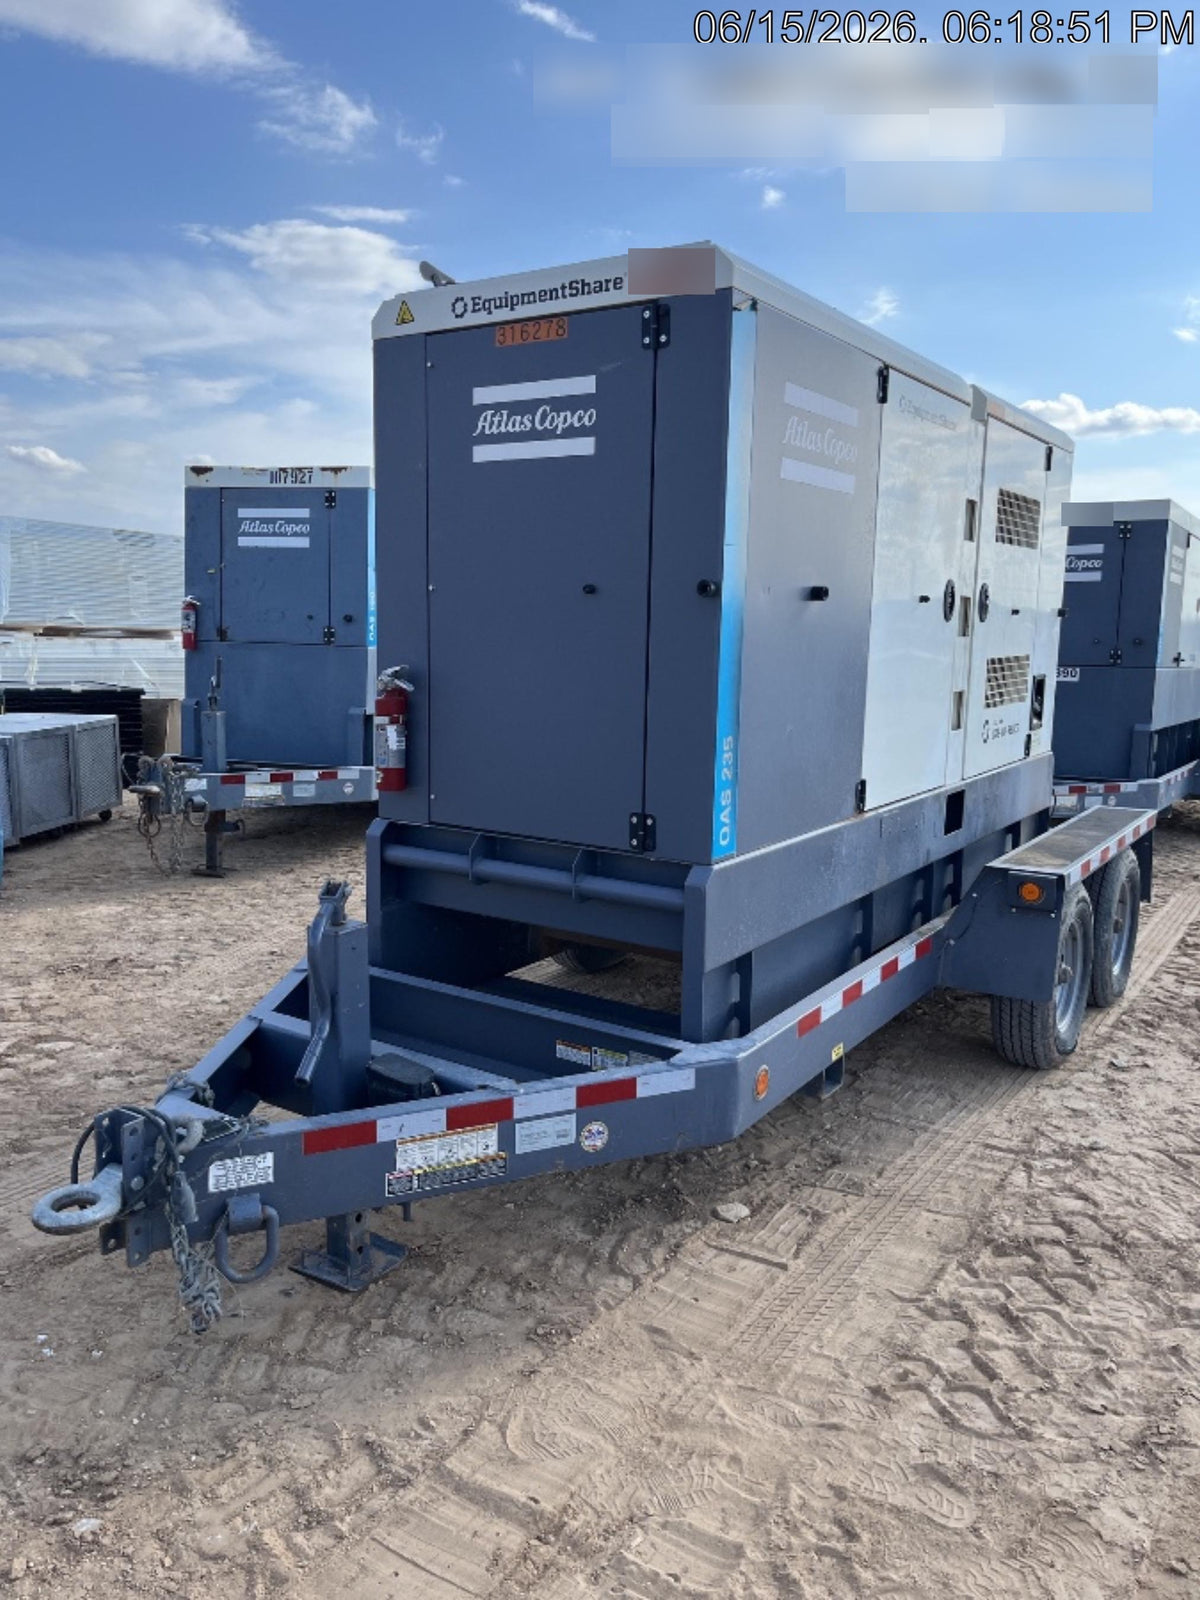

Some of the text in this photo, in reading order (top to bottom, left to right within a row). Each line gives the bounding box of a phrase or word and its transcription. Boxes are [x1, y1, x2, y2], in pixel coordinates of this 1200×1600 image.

[470, 276, 624, 315] EquipmentShare
[497, 318, 566, 346] 316278
[472, 405, 596, 436] Atlas Copco
[782, 416, 822, 453] Atlas
[239, 520, 311, 536] Atlas Copco
[1066, 556, 1103, 571] Copco
[722, 736, 734, 780] 235
